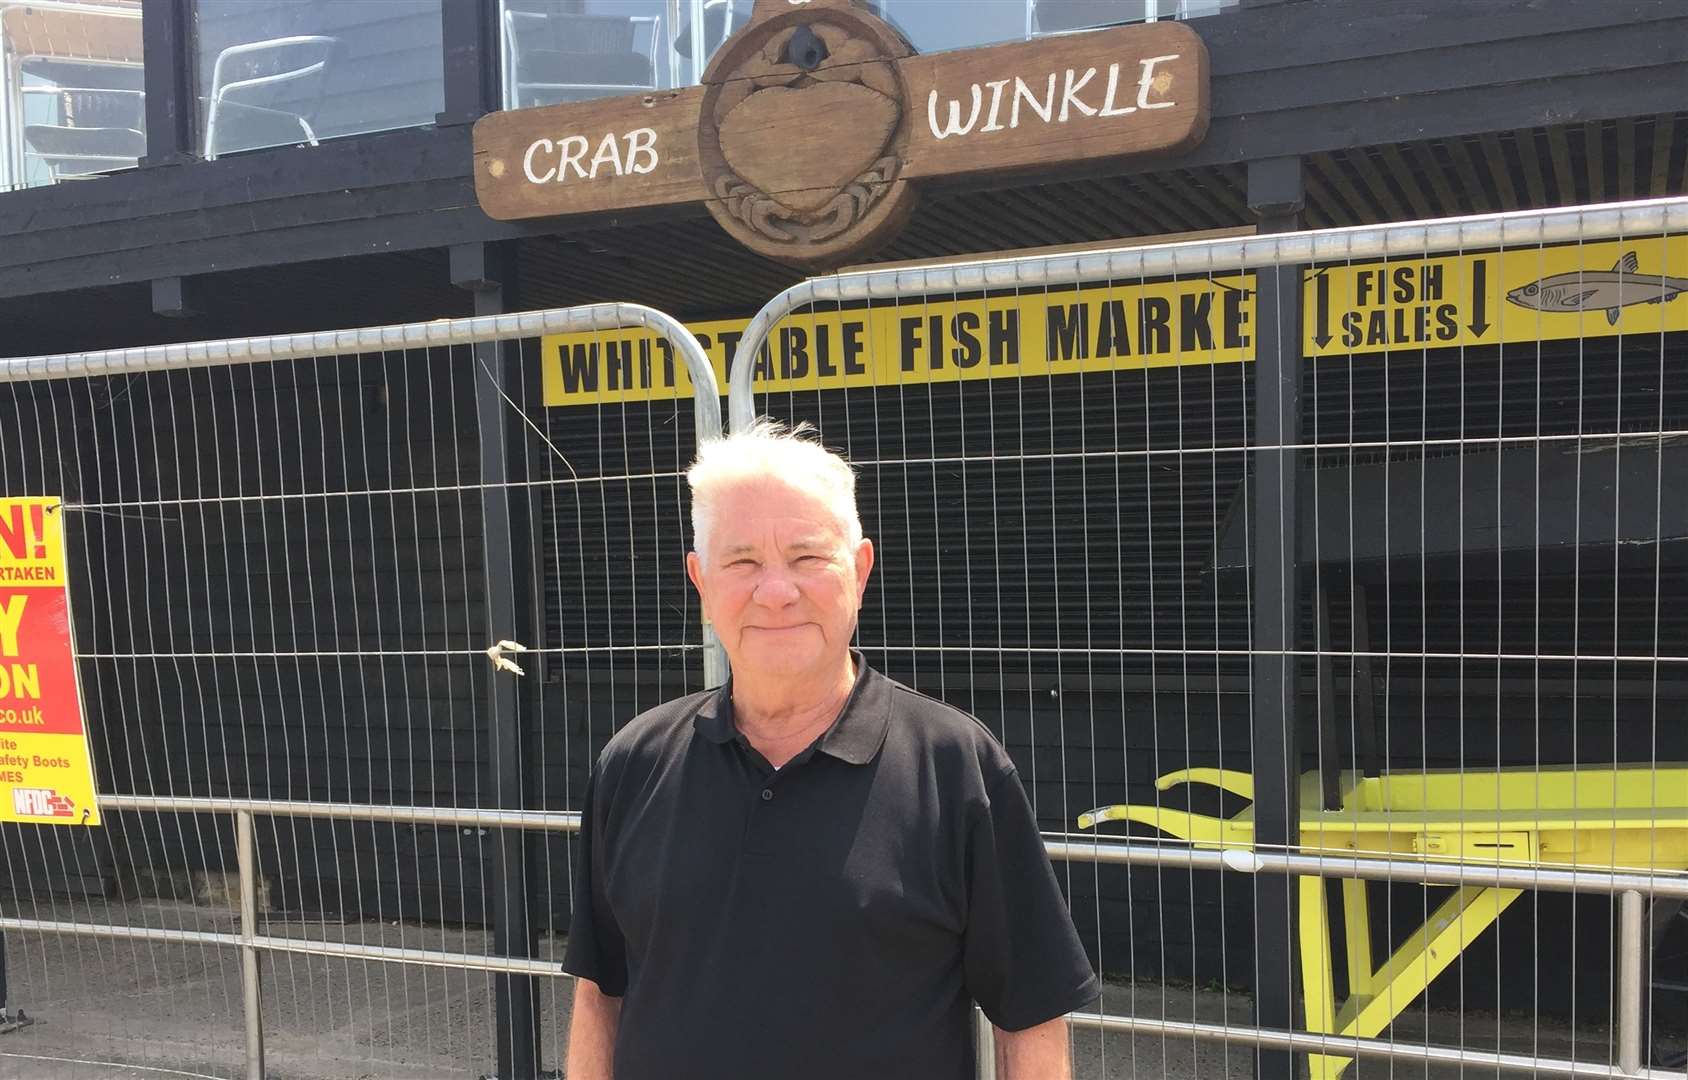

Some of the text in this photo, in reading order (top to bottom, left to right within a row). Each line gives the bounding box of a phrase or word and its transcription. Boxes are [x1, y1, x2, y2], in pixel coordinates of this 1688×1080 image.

[522, 54, 1180, 184] CRAB WINKLE
[1357, 264, 1443, 306] FISH
[900, 308, 1019, 372] FISH
[1046, 288, 1251, 362] MARKE
[1341, 303, 1458, 348] SALES
[33, 755, 71, 768] Boots
[14, 789, 54, 816] NFDC
